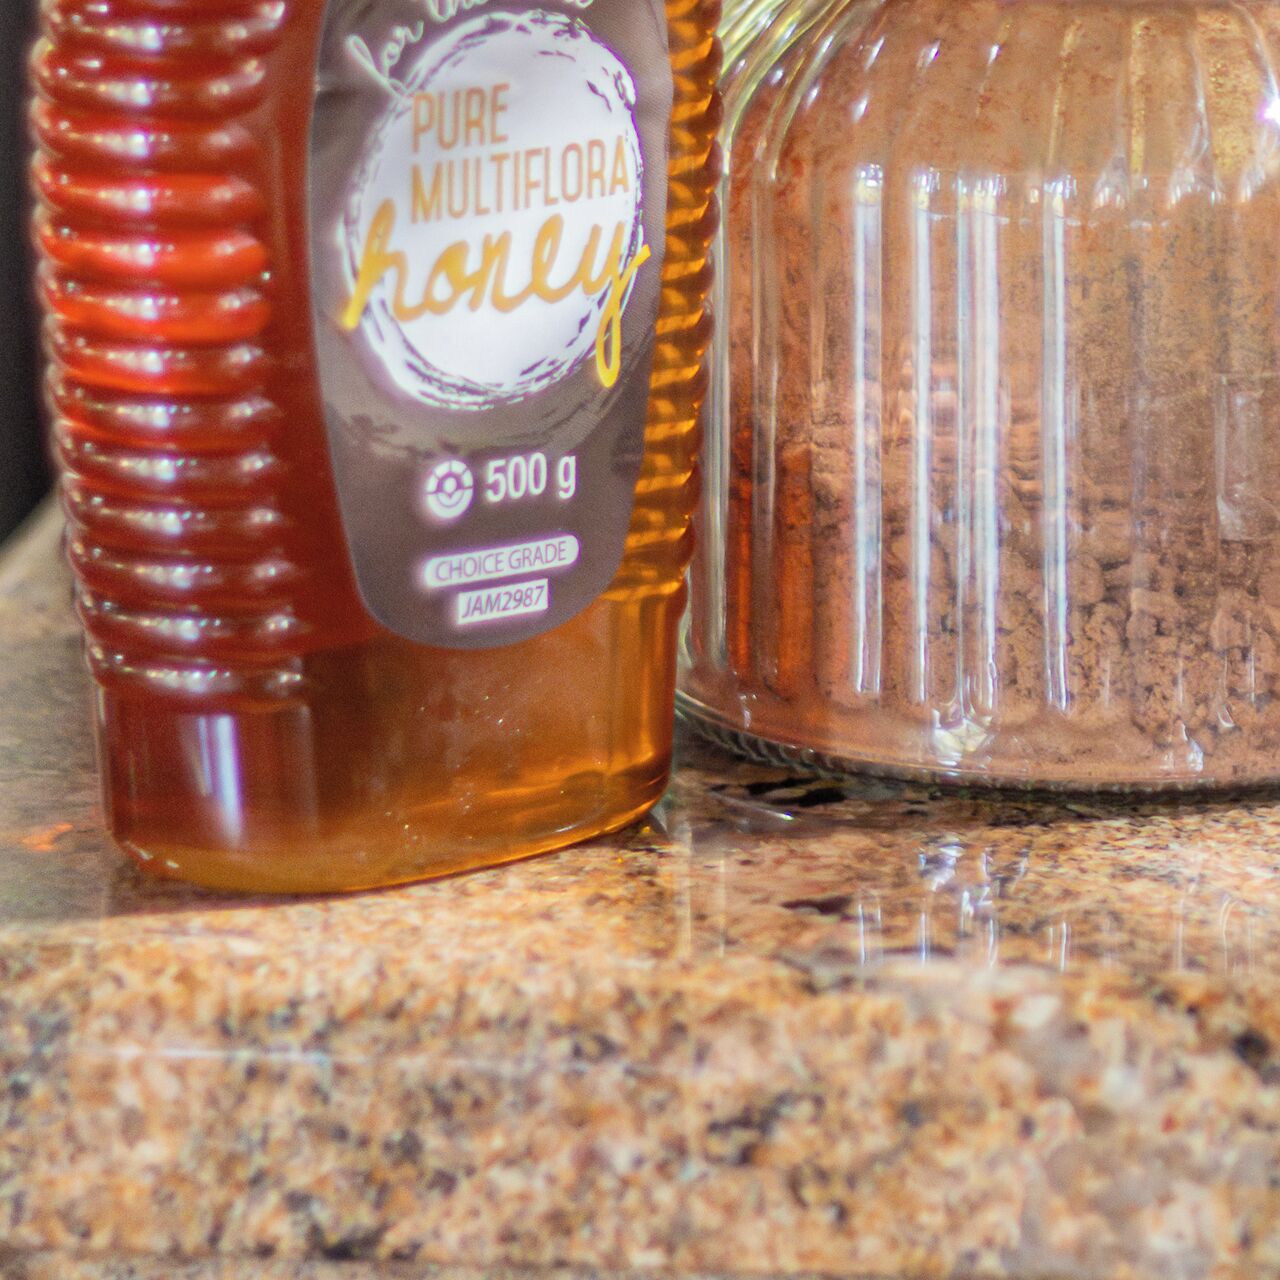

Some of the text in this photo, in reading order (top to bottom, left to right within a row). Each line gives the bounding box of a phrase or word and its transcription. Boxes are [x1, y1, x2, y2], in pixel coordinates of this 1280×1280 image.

[411, 82, 511, 154] PURE
[410, 135, 631, 226] MULTIFLORA
[342, 199, 652, 389] honey
[486, 452, 577, 503] 500 g
[434, 540, 568, 583] CHOICE GRADE
[461, 585, 546, 619] JAM2987
